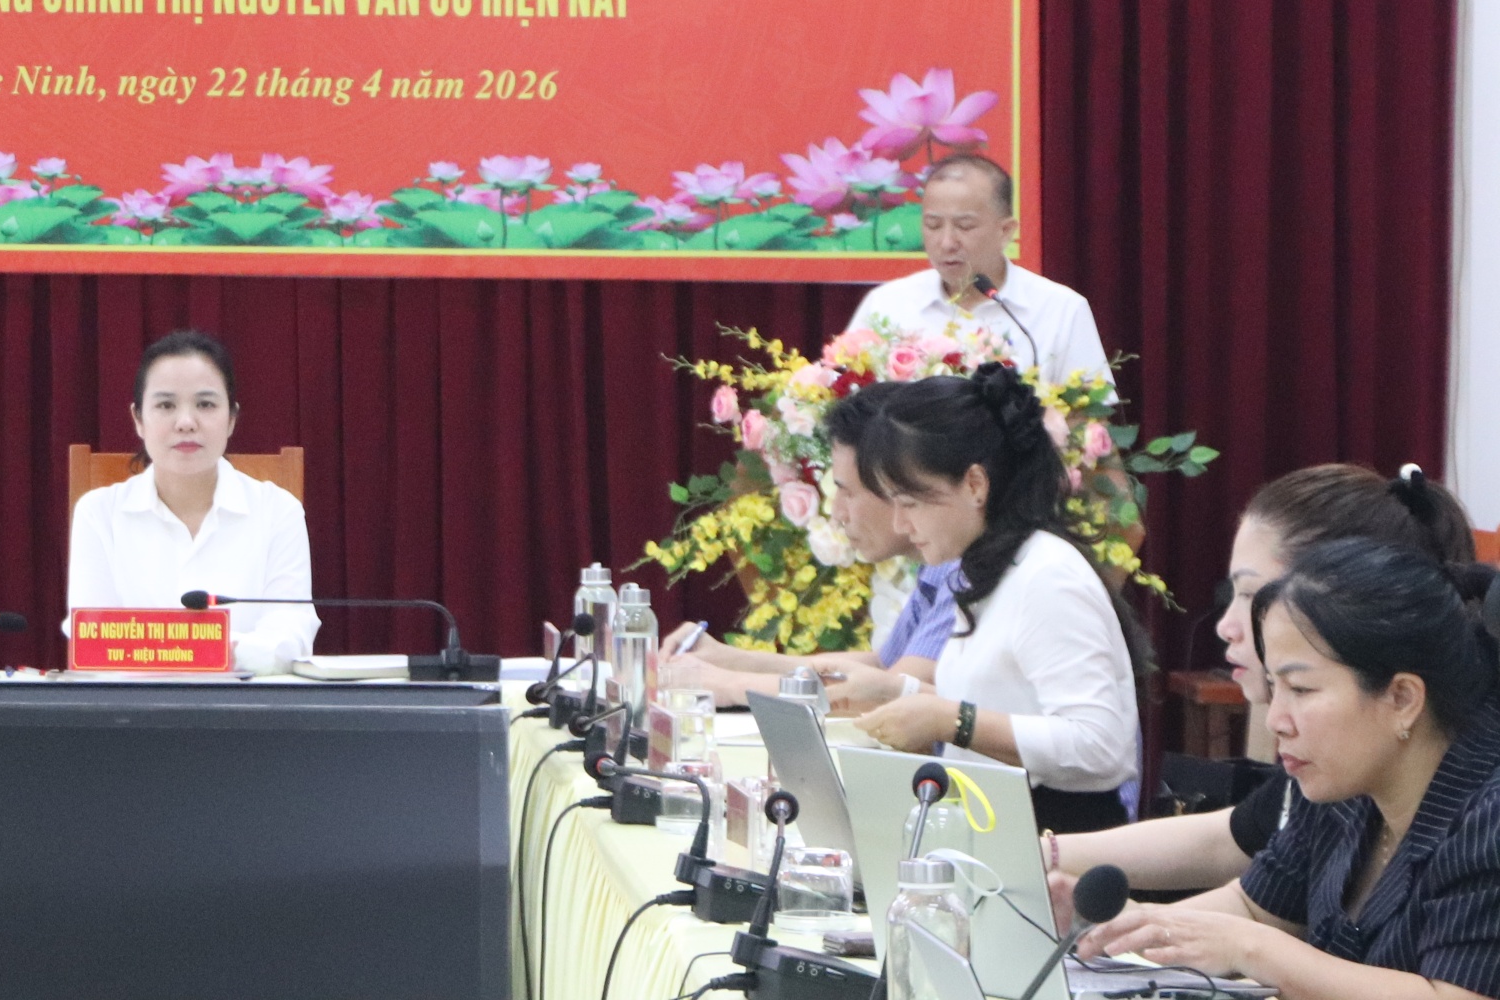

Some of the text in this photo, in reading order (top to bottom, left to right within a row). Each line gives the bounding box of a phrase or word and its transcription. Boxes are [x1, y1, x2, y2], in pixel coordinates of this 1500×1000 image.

[11, 65, 107, 102] Ninh,
[117, 66, 197, 105] ngày
[206, 66, 248, 98] 22
[255, 67, 355, 106] tháng
[361, 68, 383, 98] 4
[390, 69, 464, 100] năm
[474, 69, 559, 101] 2026
[147, 621, 165, 643] THỊ
[167, 622, 189, 640] KIM
[191, 622, 223, 640] DUNG
